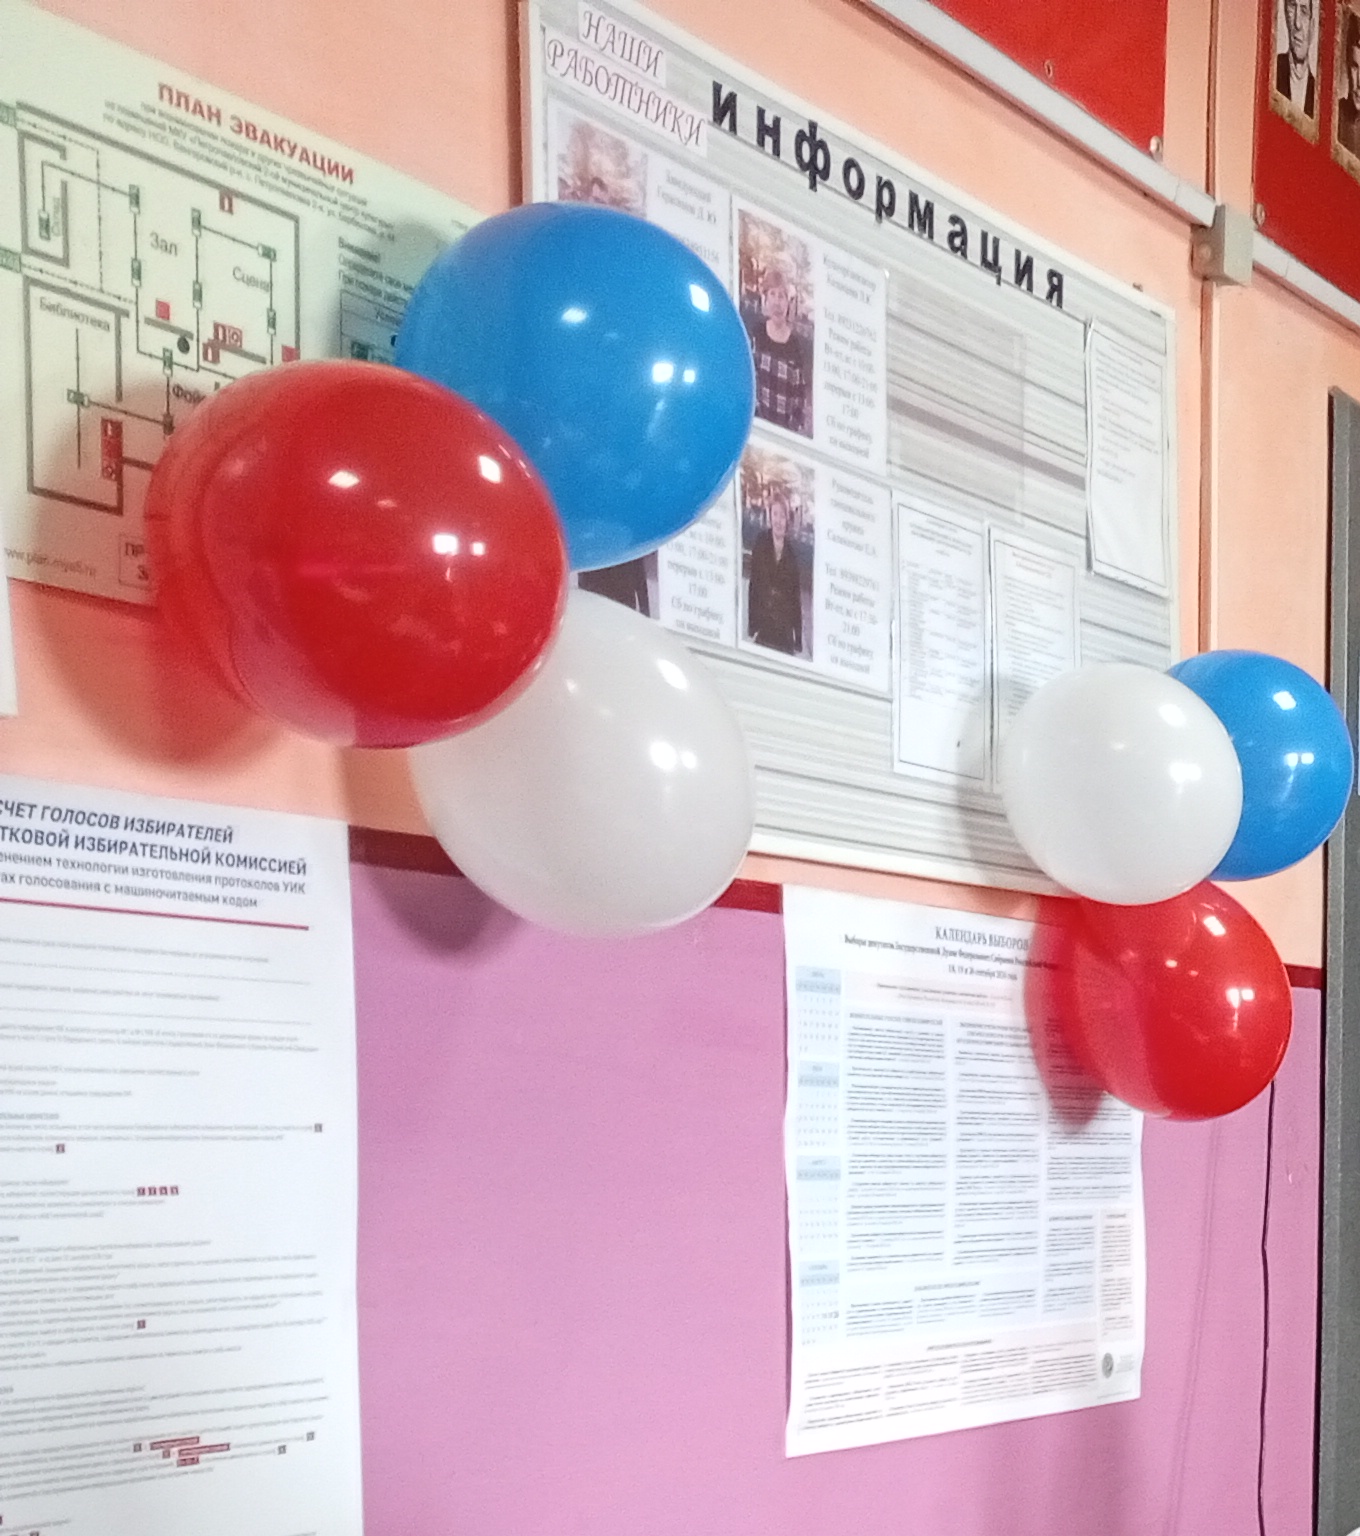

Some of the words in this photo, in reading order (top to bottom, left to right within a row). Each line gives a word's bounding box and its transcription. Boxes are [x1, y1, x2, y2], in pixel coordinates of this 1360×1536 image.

[582, 9, 664, 78] НАШИ
[547, 37, 705, 147] РАБОТНИКИ
[158, 82, 222, 126] ПЛАН
[229, 113, 355, 185] ЭВАКУАЦИИ
[150, 231, 178, 256] Зал
[39, 297, 110, 331] Библиотека
[0, 800, 37, 820] ЧЕТ
[41, 805, 121, 830] ГОЛОСОВ
[123, 816, 233, 843] ИЗБИРАТЕЛЕЙ
[0, 825, 70, 849] ТКОВОЙ
[73, 834, 211, 865] ИЗБИРАТЕЛЬНОЙ
[215, 851, 307, 876] КОМИССИЕЙ
[1, 872, 15, 884] ах
[19, 873, 101, 892] голосования
[104, 883, 111, 894] с
[114, 883, 219, 904] машиночитаемым
[222, 895, 258, 908] кодом
[56, 857, 129, 875] технологии
[131, 866, 212, 884] изготовления
[214, 875, 280, 892] протоколов
[282, 881, 306, 895] УИК
[934, 926, 987, 944] КАЛЕНДАРЬ
[988, 936, 1029, 951] ВЫБОРОВ
